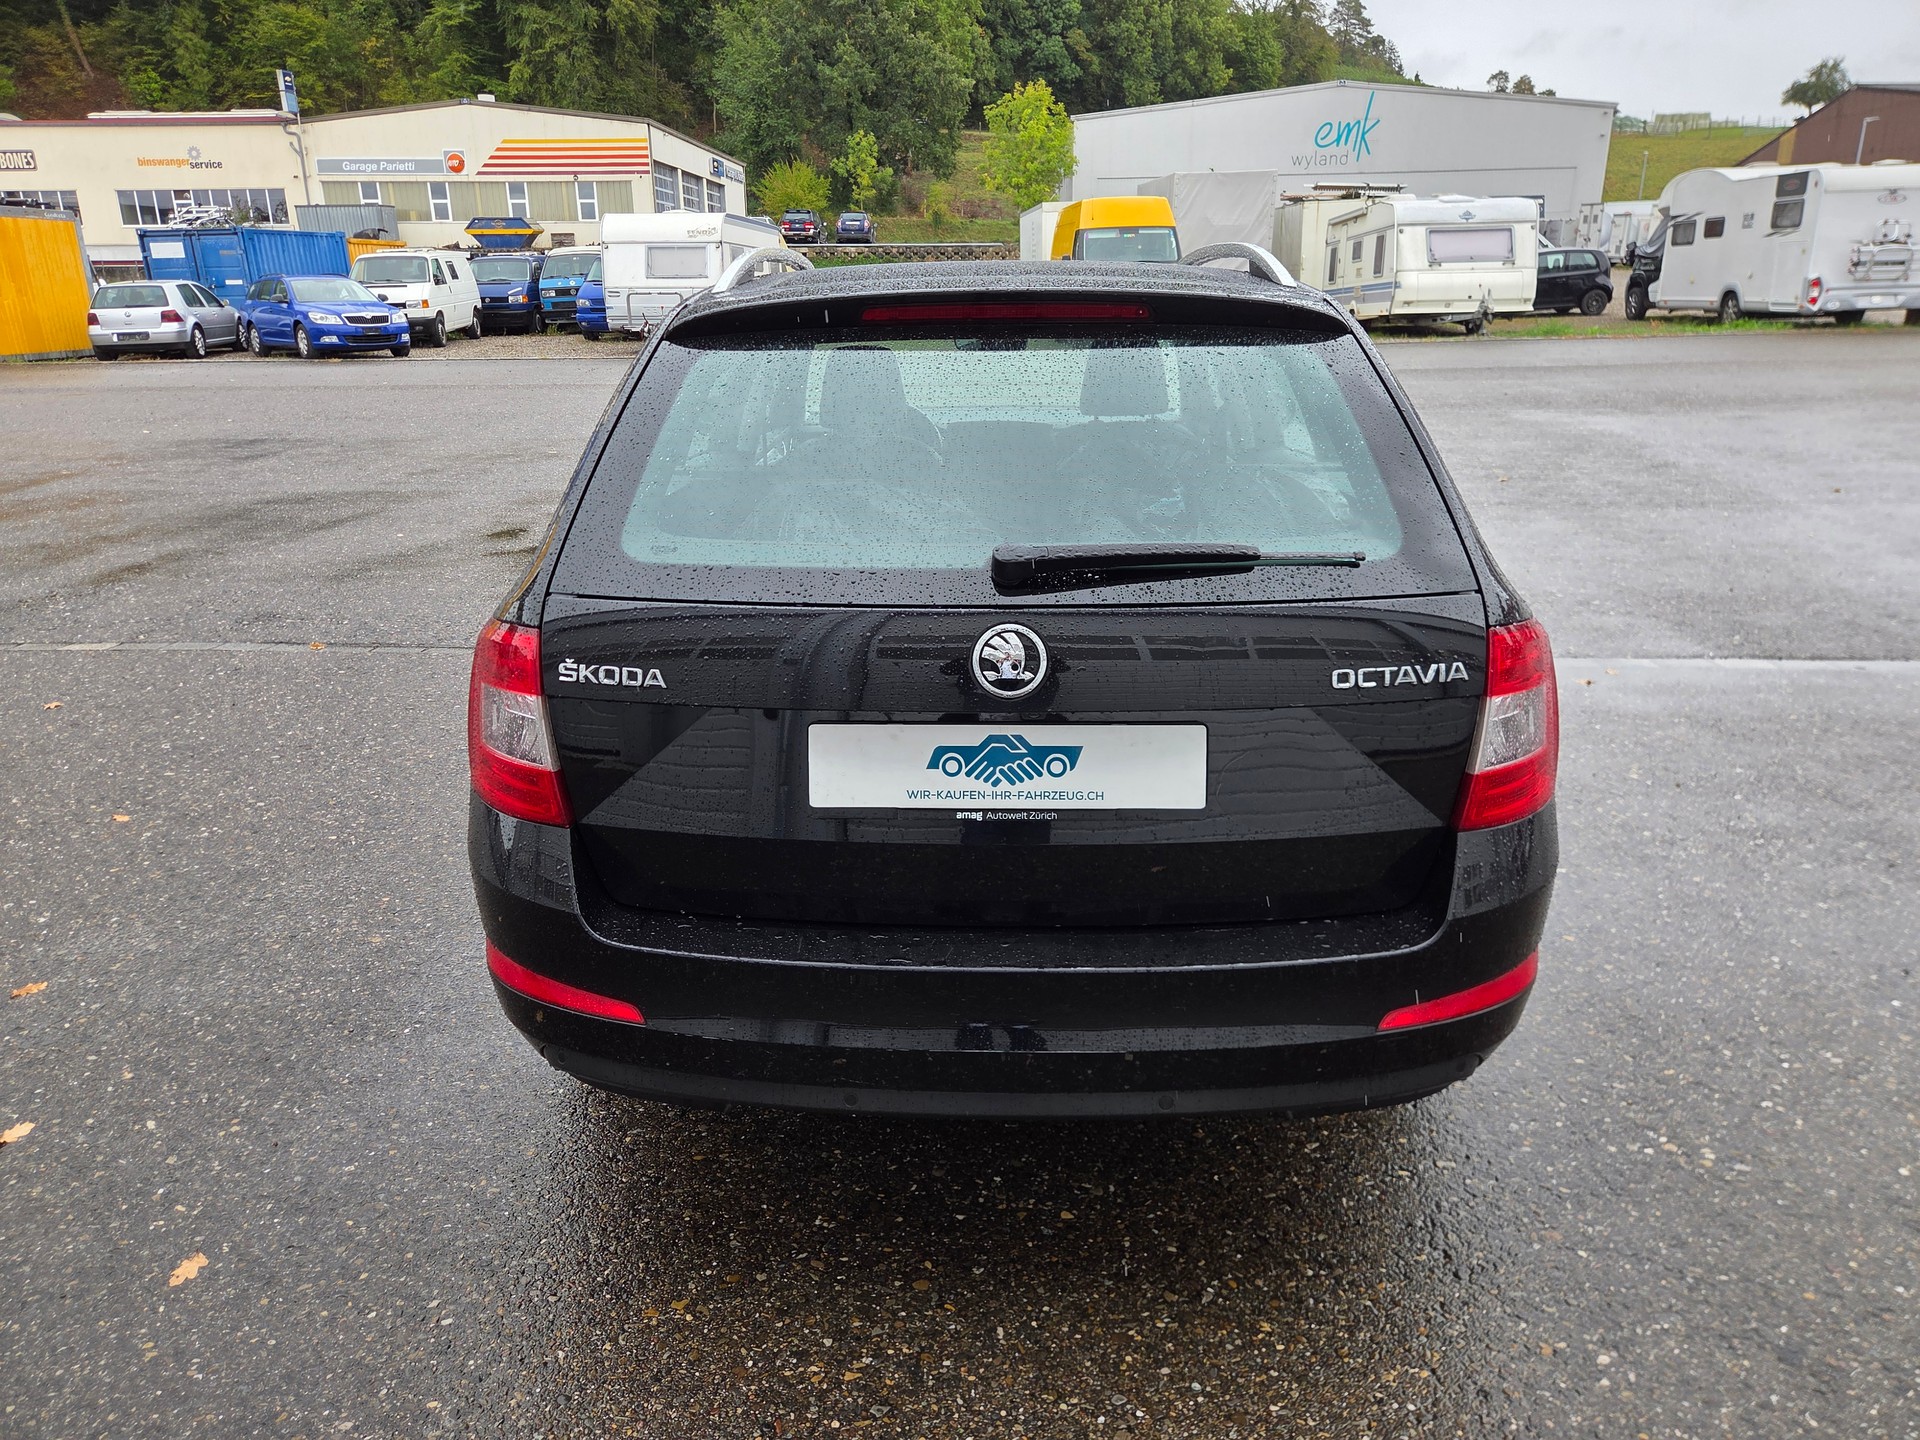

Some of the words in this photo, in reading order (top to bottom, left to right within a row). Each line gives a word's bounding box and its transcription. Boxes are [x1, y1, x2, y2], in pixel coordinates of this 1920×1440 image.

[1314, 91, 1380, 162] emk
[0, 152, 35, 169] BONES
[137, 157, 190, 168] binswanger
[190, 160, 223, 169] service
[342, 161, 378, 172] Garage
[380, 161, 415, 171] Parietti
[1291, 150, 1349, 170] wyland
[558, 658, 667, 689] ŠKODA
[1331, 661, 1470, 690] OCTAVIA
[906, 789, 1105, 801] WIR-KAUFEN-IHR-FAHRZEUG.CH
[956, 811, 983, 821] amag
[986, 811, 1028, 820] Autowelt
[1029, 811, 1058, 820] Zürich
